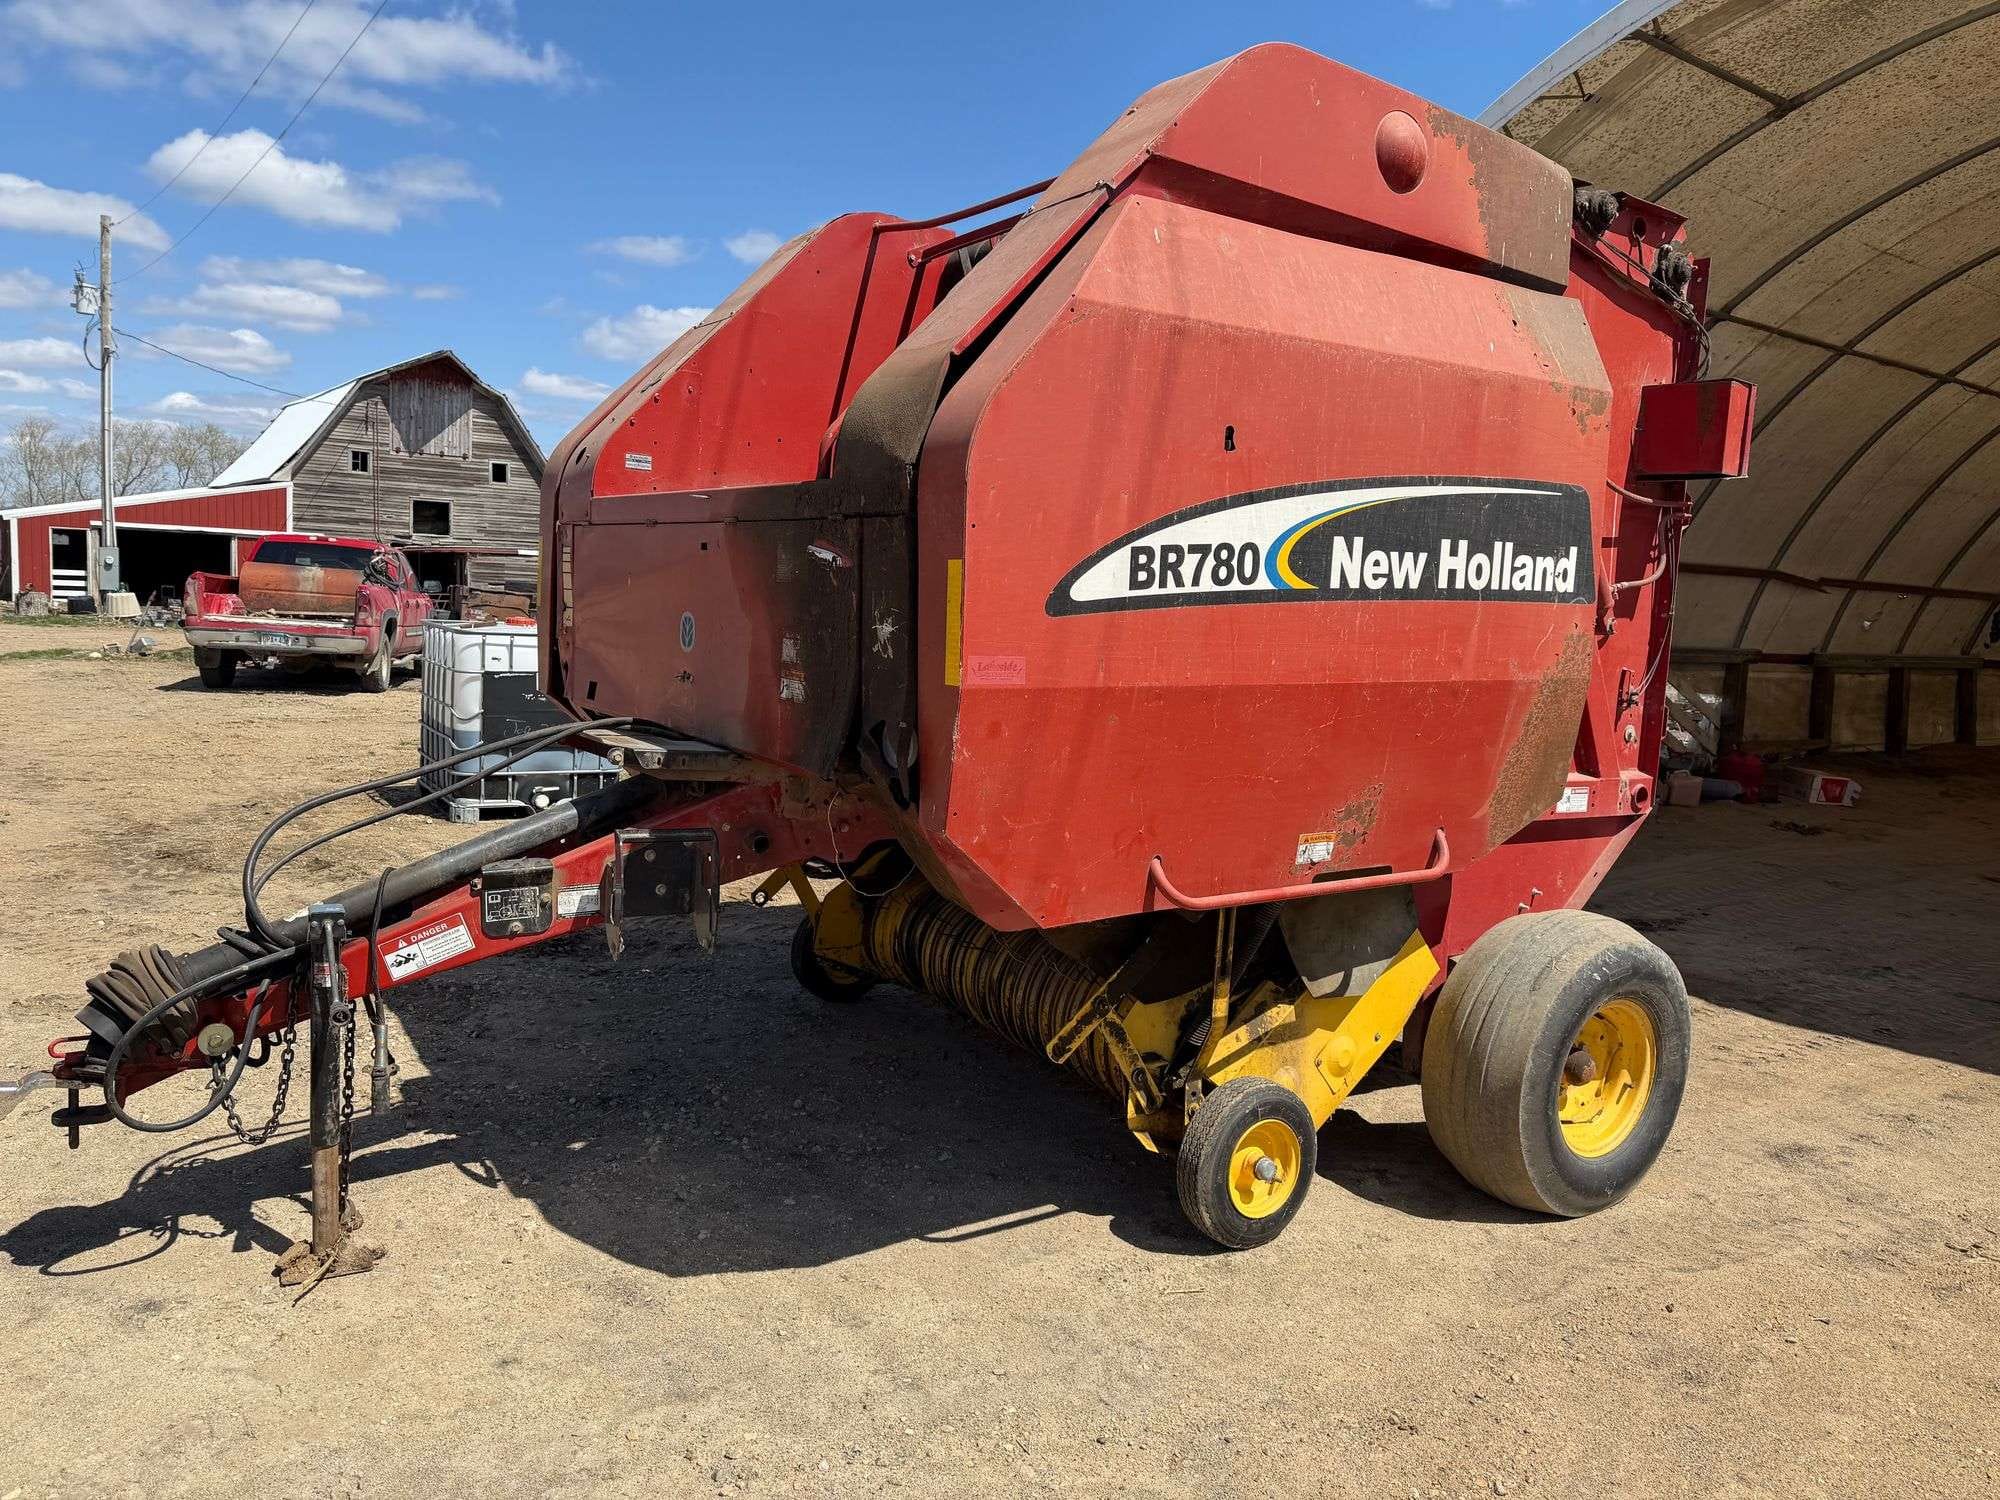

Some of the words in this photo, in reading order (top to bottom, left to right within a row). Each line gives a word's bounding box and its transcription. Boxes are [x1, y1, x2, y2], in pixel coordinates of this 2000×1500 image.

[1128, 541, 1261, 591] BR780
[1330, 535, 1428, 590] New
[1434, 538, 1578, 593] Holland
[977, 660, 1018, 672] Laside
[411, 923, 448, 942] DANGER
